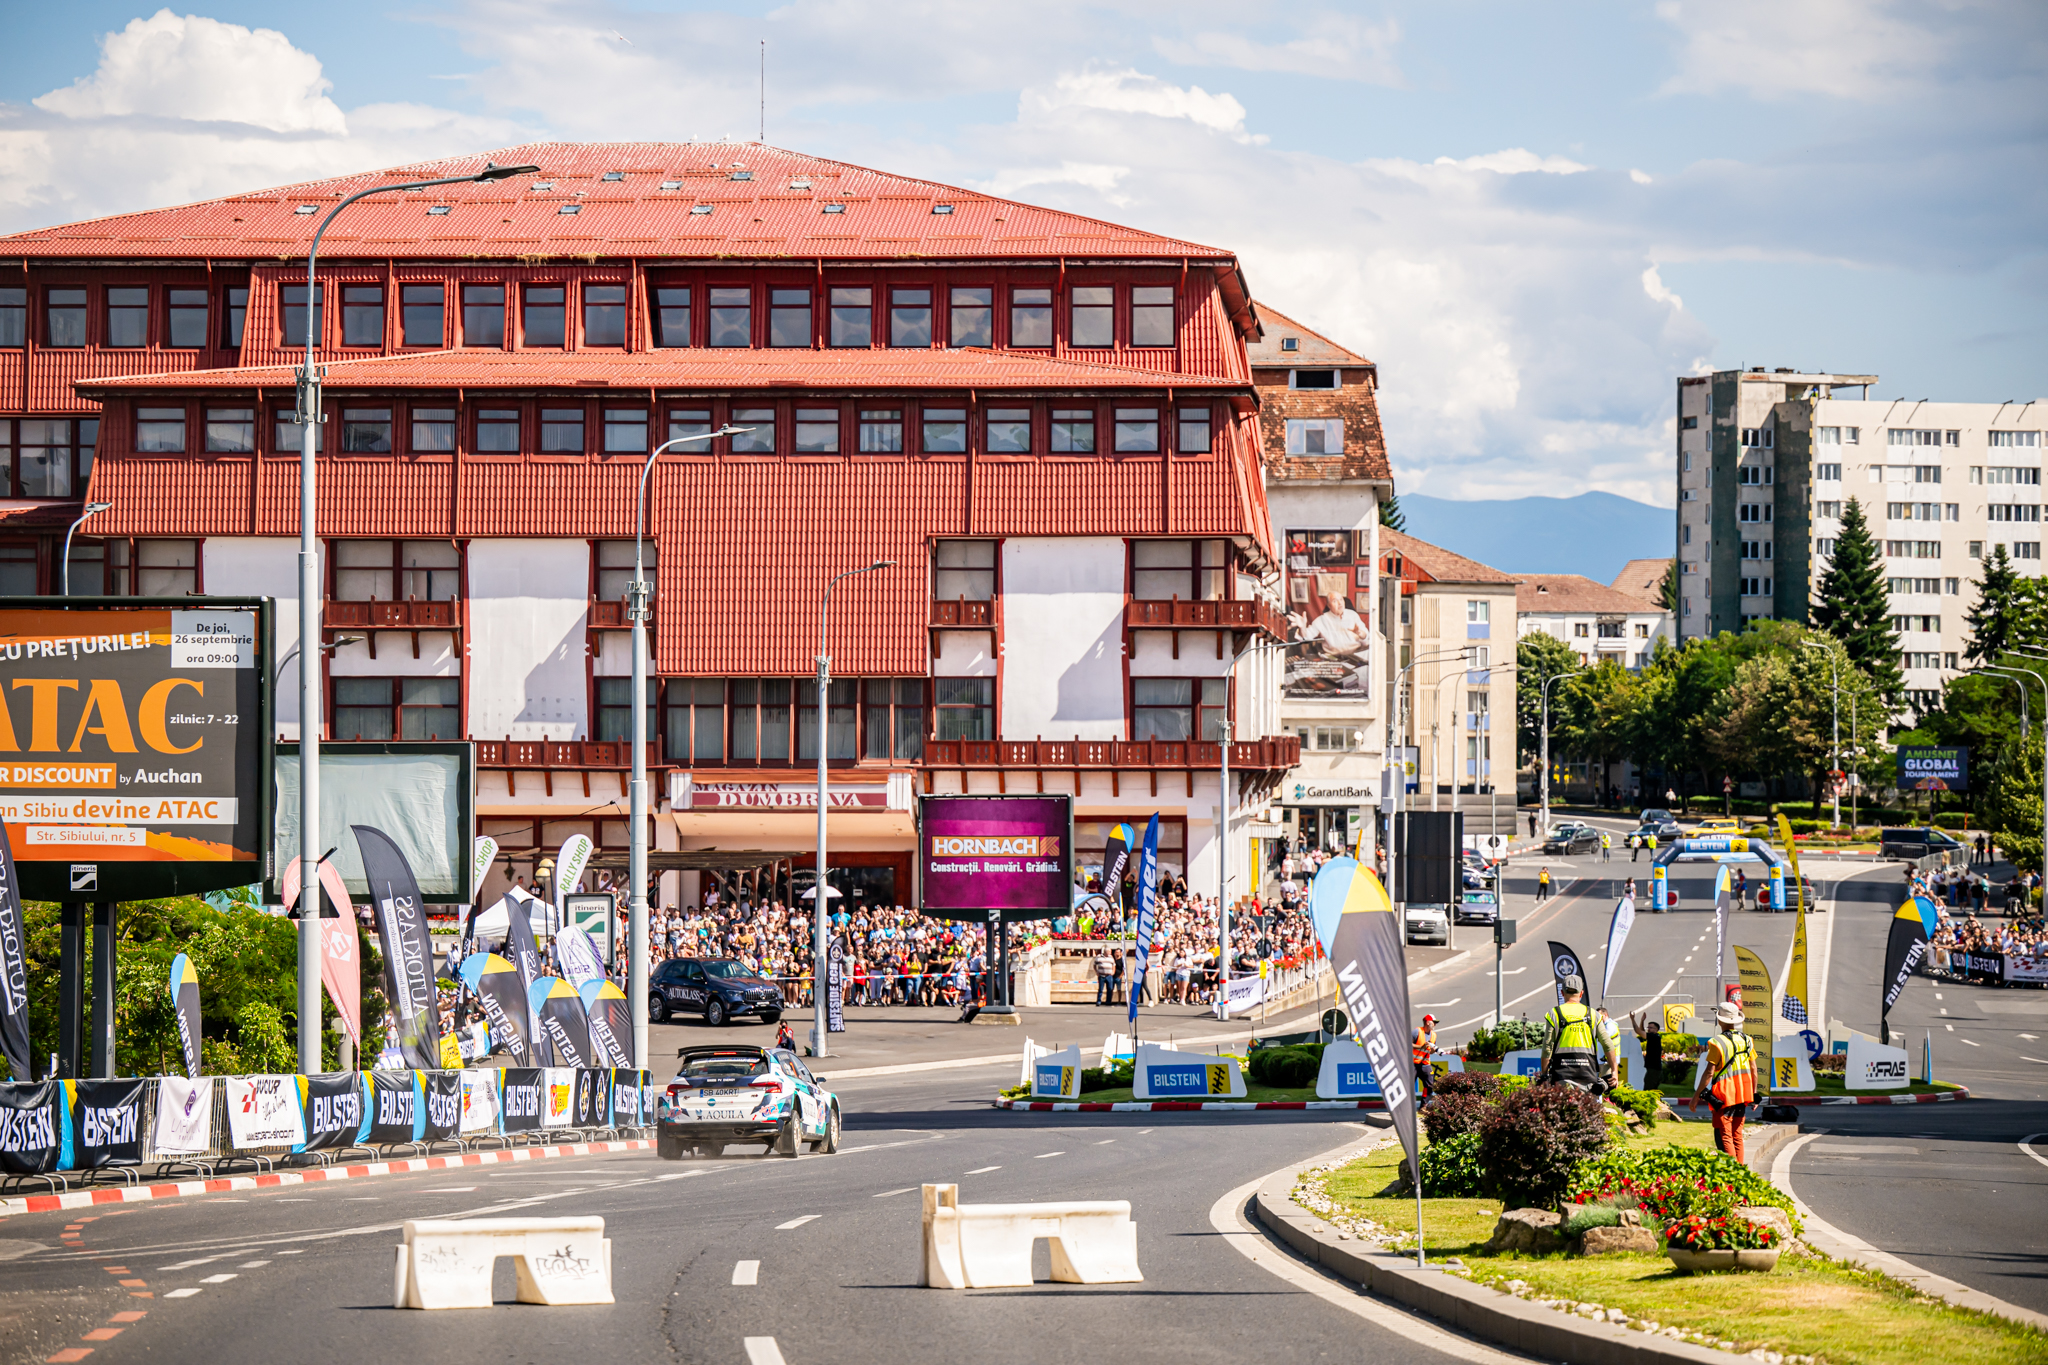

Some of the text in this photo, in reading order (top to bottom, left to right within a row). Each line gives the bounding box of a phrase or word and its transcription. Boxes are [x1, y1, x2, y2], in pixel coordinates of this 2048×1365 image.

[196, 624, 230, 634] De joi,
[175, 634, 252, 646] 26 septembrie
[206, 654, 240, 663] 09:00
[170, 714, 204, 724] zilnic:
[208, 714, 214, 724] 7
[224, 714, 238, 724] 22
[1905, 750, 1958, 758] AMUSNET
[1905, 759, 1959, 770] GLOBAL
[14, 768, 112, 783] DISCOUNT
[120, 774, 132, 786] by
[134, 768, 202, 784] Auchan
[696, 784, 780, 792] MAGAZIN
[1308, 787, 1373, 797] GarantiBank
[718, 793, 863, 806] DUMBRAVA
[24, 803, 68, 817] Sibiu
[73, 799, 150, 818] devine
[156, 801, 218, 819] ATAC
[36, 831, 136, 842] Str. Sibiului, nr. 5
[934, 838, 1036, 854] HORNBACH
[476, 840, 494, 866] SHOP
[560, 838, 589, 892] RALLY SHOP
[931, 861, 1060, 875] Construcții. Renovări. Grădină.
[1104, 850, 1128, 897] BILSTEIN
[1968, 954, 1999, 974] ILSTEIN
[668, 988, 700, 1000] AUTOKLASS
[830, 986, 840, 1032] SAFESIDE
[1876, 1061, 1905, 1077] FRAS
[1039, 1074, 1058, 1087] BILSTEIN
[1153, 1073, 1200, 1087] BILSTEIN
[1346, 1072, 1377, 1085] BILS
[506, 1085, 540, 1116] BILSTEIN
[313, 1092, 359, 1134] BILSTEIN
[379, 1090, 414, 1125] BILSTE
[706, 1110, 744, 1120] AQUILA
